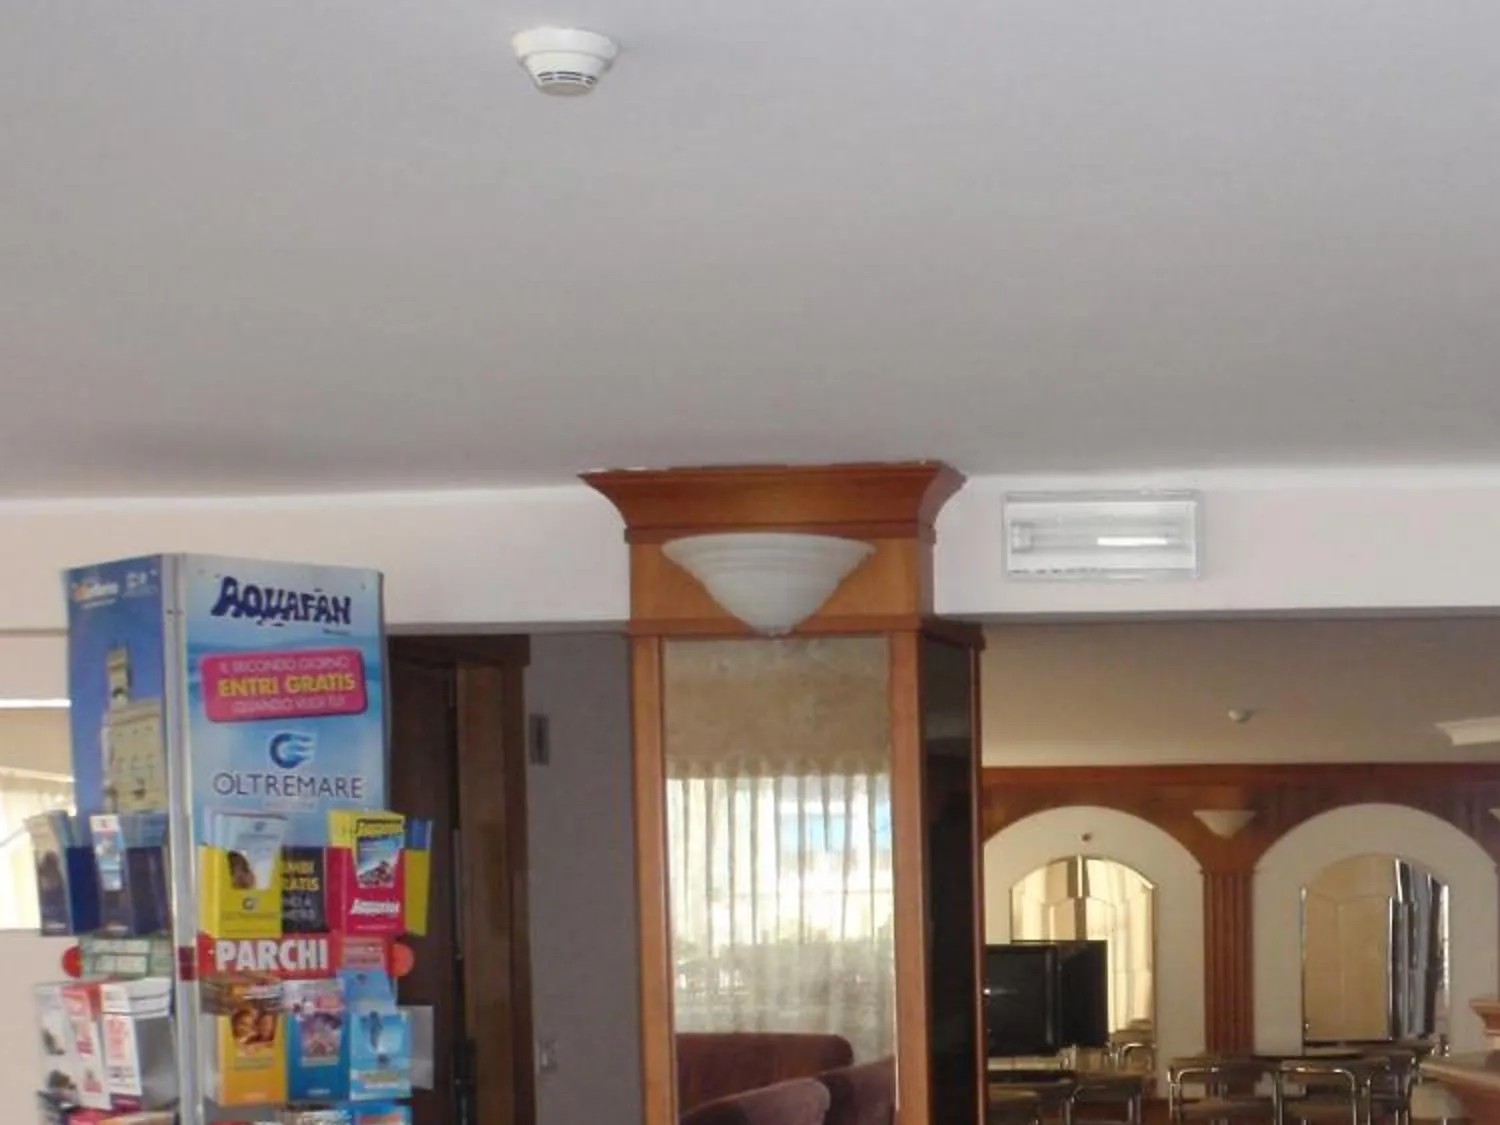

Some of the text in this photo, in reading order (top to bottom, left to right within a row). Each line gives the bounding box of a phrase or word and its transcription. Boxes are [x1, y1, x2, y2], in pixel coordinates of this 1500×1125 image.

[210, 576, 352, 626] AQUAFAN
[217, 671, 357, 698] ENTRI GRATIS
[212, 771, 364, 799] OLTREMARE
[214, 938, 328, 972] PARCHI
